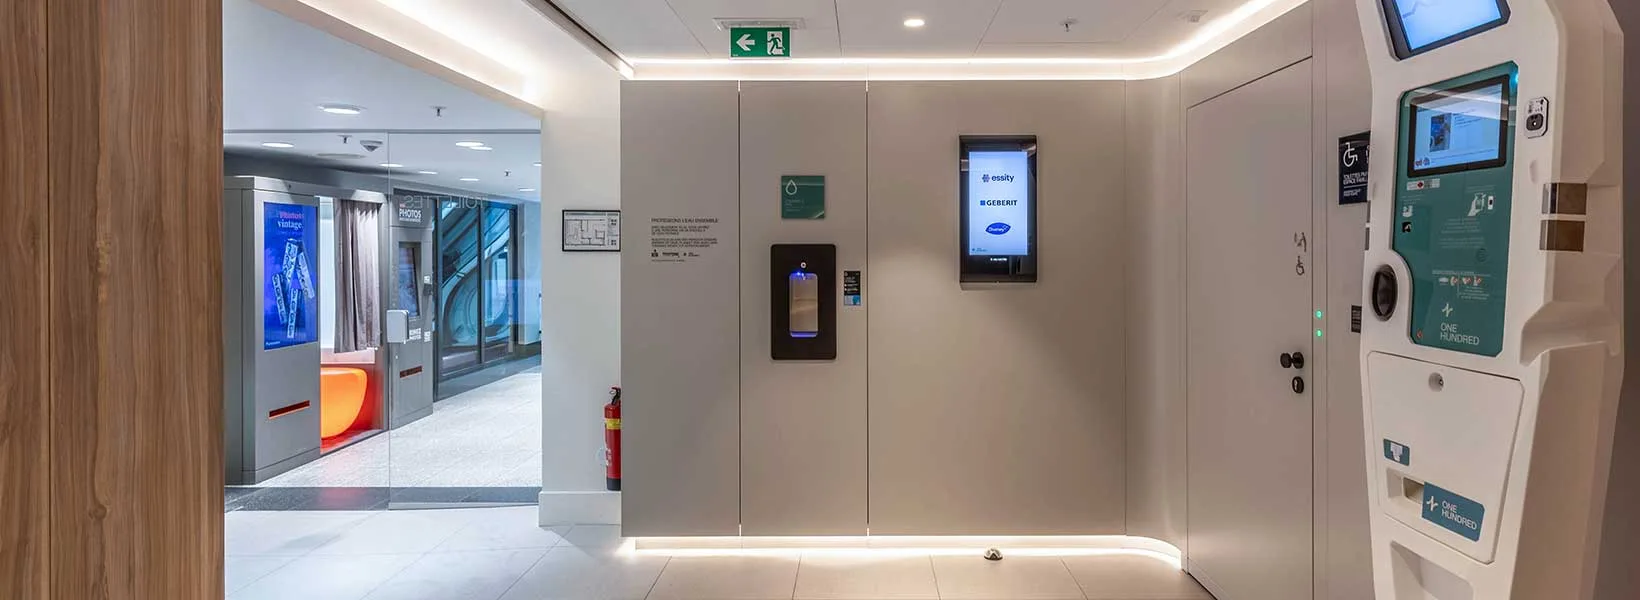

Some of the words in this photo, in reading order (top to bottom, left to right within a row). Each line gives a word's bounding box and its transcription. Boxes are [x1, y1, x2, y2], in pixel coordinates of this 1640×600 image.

[991, 173, 1015, 183] essity
[986, 199, 1018, 207] GEBERIT
[399, 208, 422, 219] PHOTOS
[1440, 322, 1457, 333] ONE
[1440, 332, 1480, 346] HUNDRED
[1441, 500, 1457, 514] ONE
[1441, 509, 1477, 530] HUNDRED
